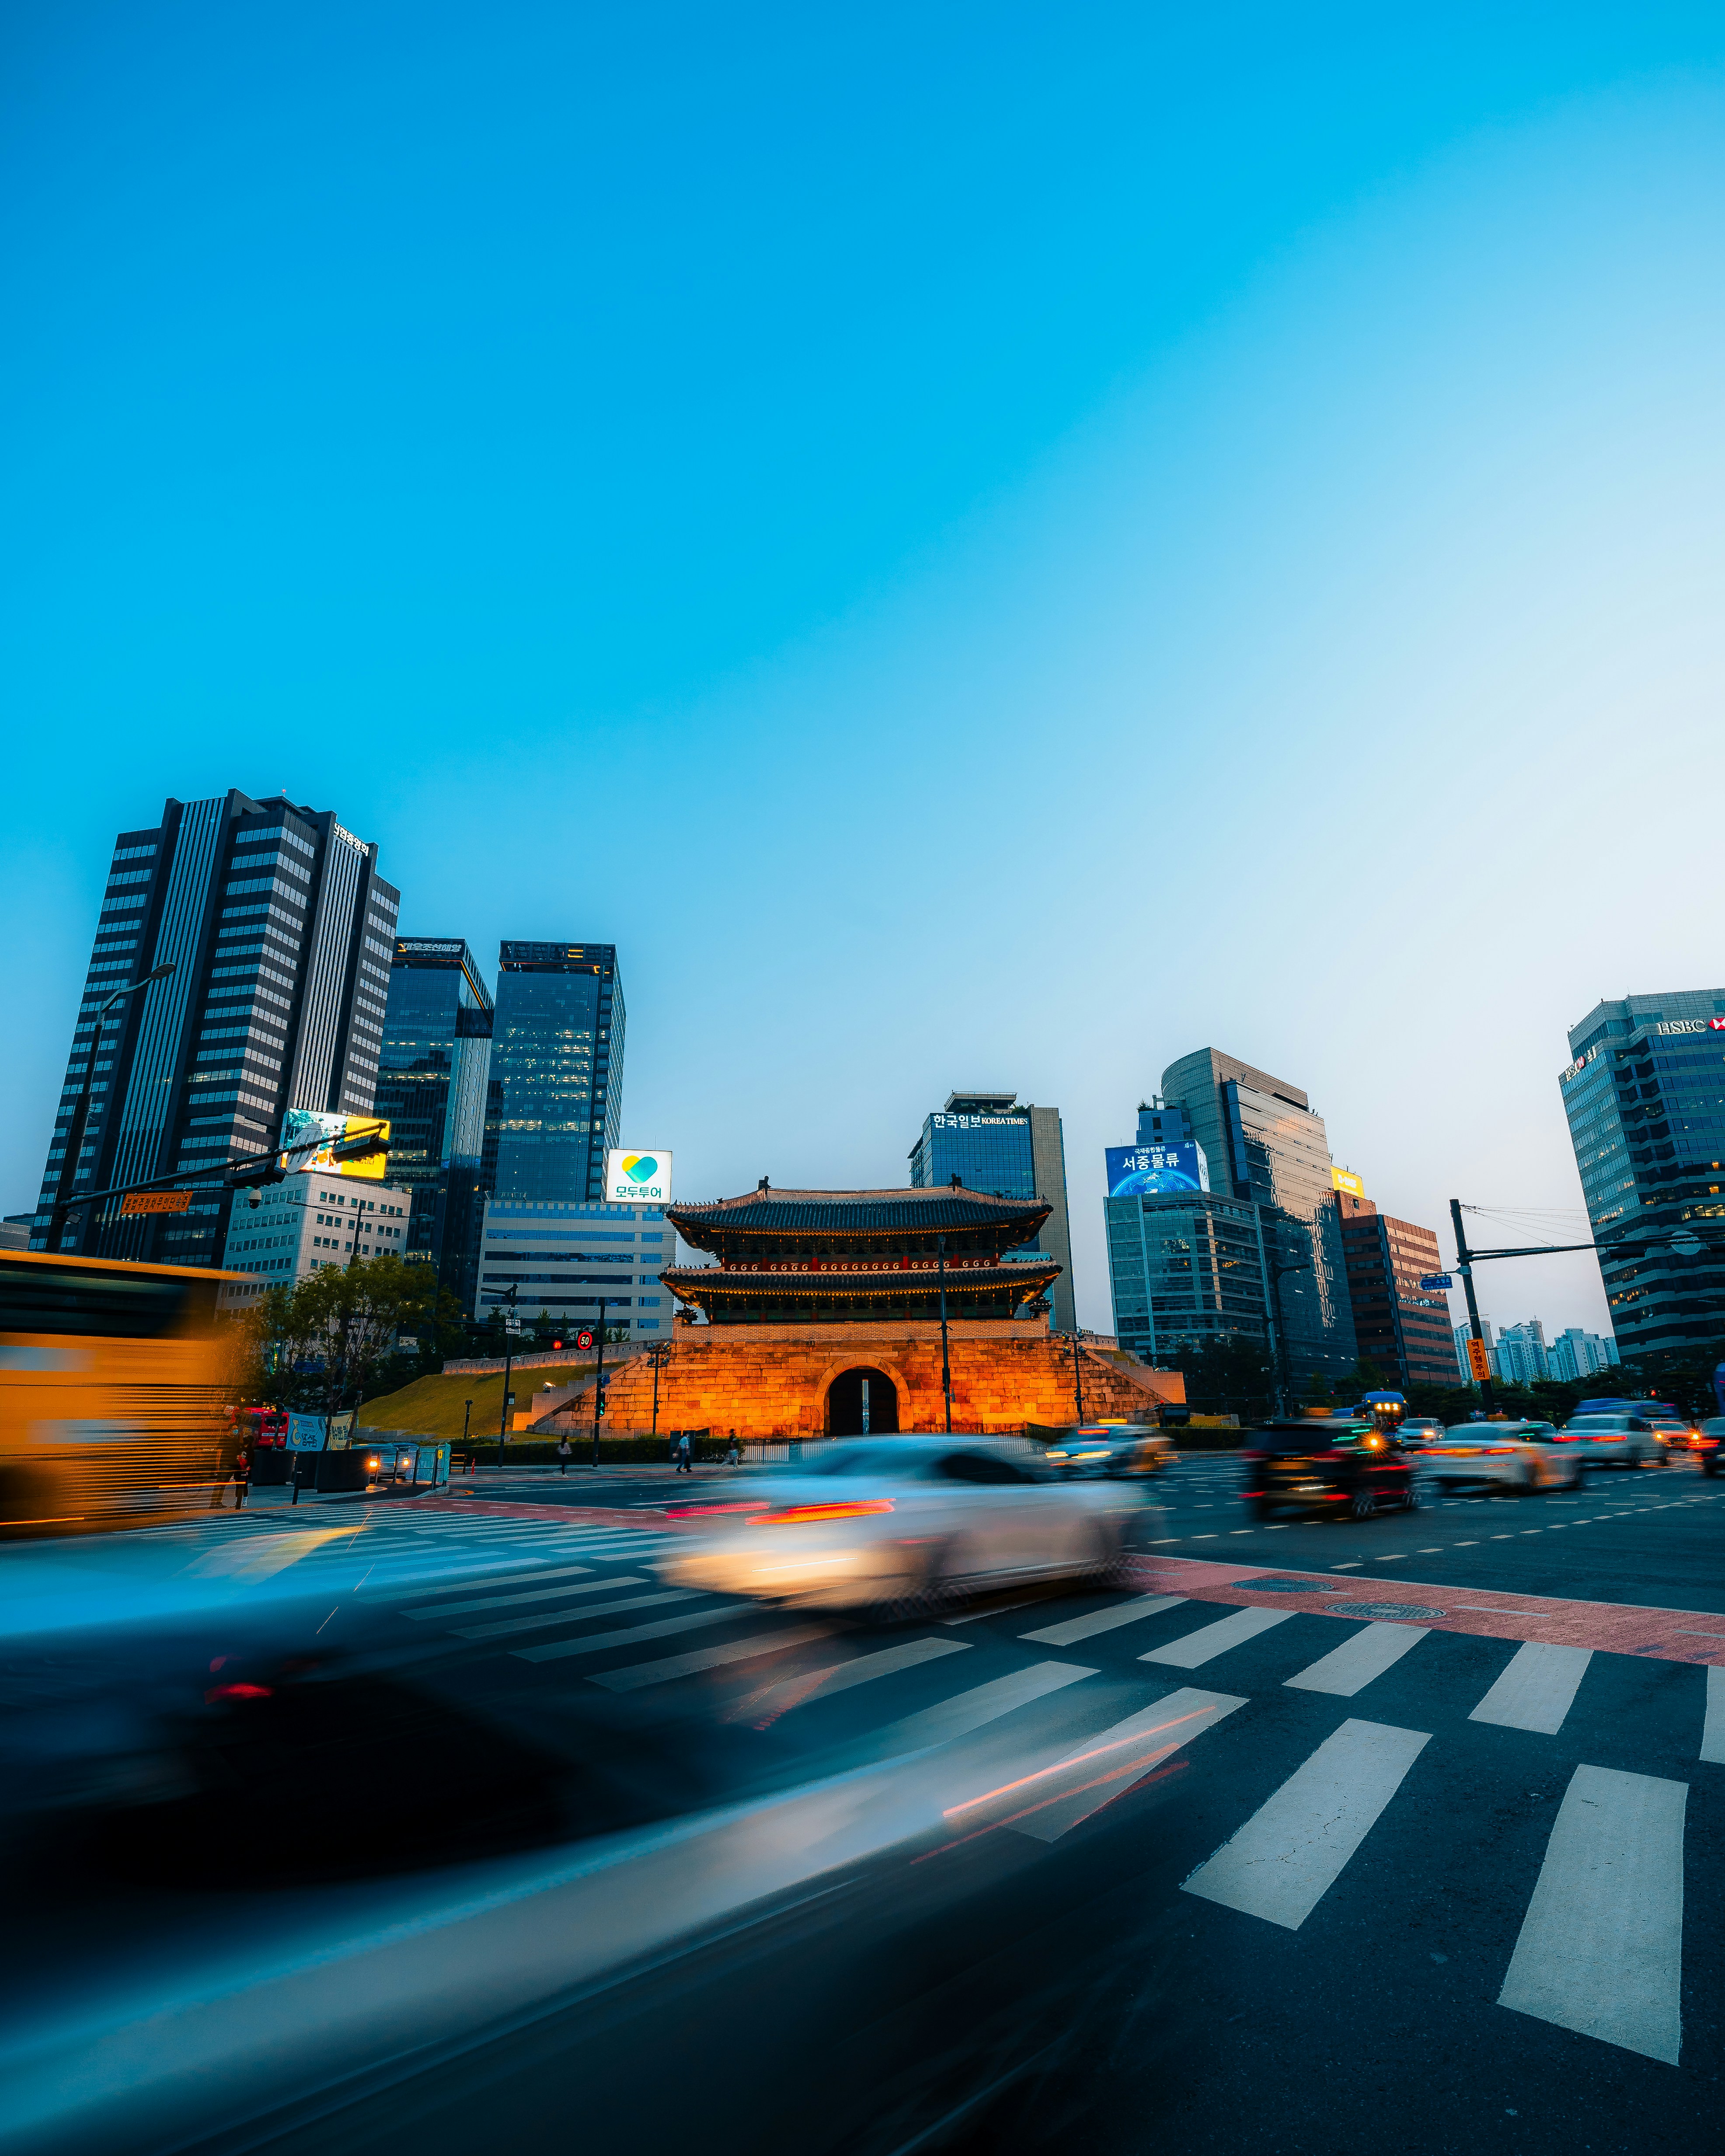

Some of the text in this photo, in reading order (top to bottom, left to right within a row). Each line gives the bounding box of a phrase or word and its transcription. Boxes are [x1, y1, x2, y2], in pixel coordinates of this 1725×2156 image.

[1657, 1019, 1707, 1035] HSBC
[933, 1115, 982, 1129] 한국일보
[1134, 1146, 1166, 1154] 국제종합물류
[1122, 1153, 1180, 1170] 서중물류
[616, 1186, 661, 1198] 모두투어
[581, 1337, 589, 1345] 50
[1471, 1341, 1485, 1378] 역주행주의
